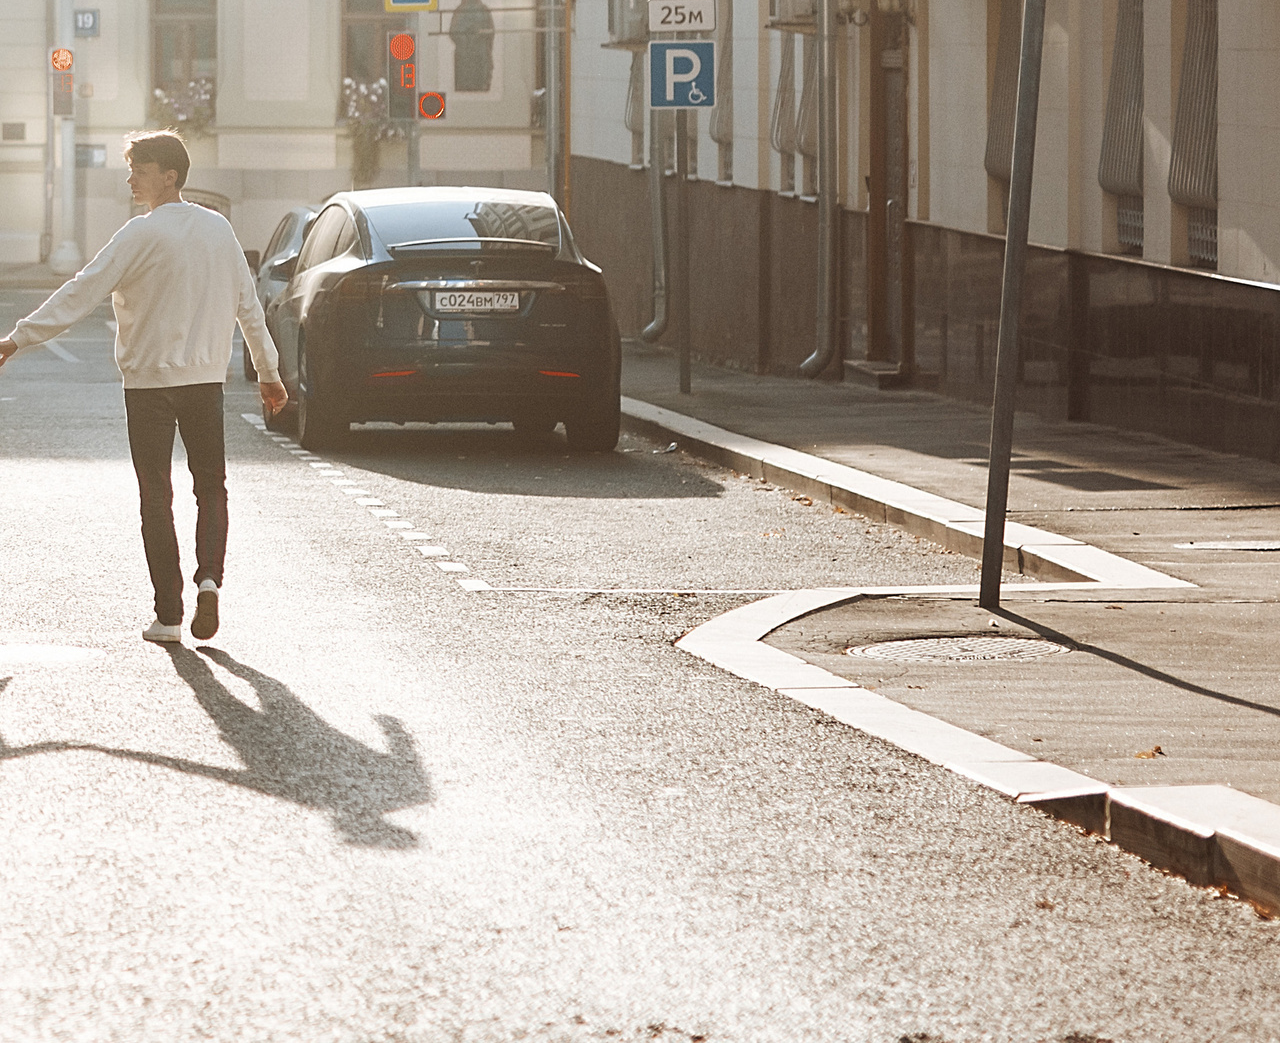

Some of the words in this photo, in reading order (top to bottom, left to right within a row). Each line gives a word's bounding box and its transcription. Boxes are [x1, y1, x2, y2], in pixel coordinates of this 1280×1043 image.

[77, 12, 94, 28] 19
[61, 74, 74, 93] 13
[400, 63, 416, 89] 13
[665, 48, 702, 101] P
[495, 293, 516, 304] 797
